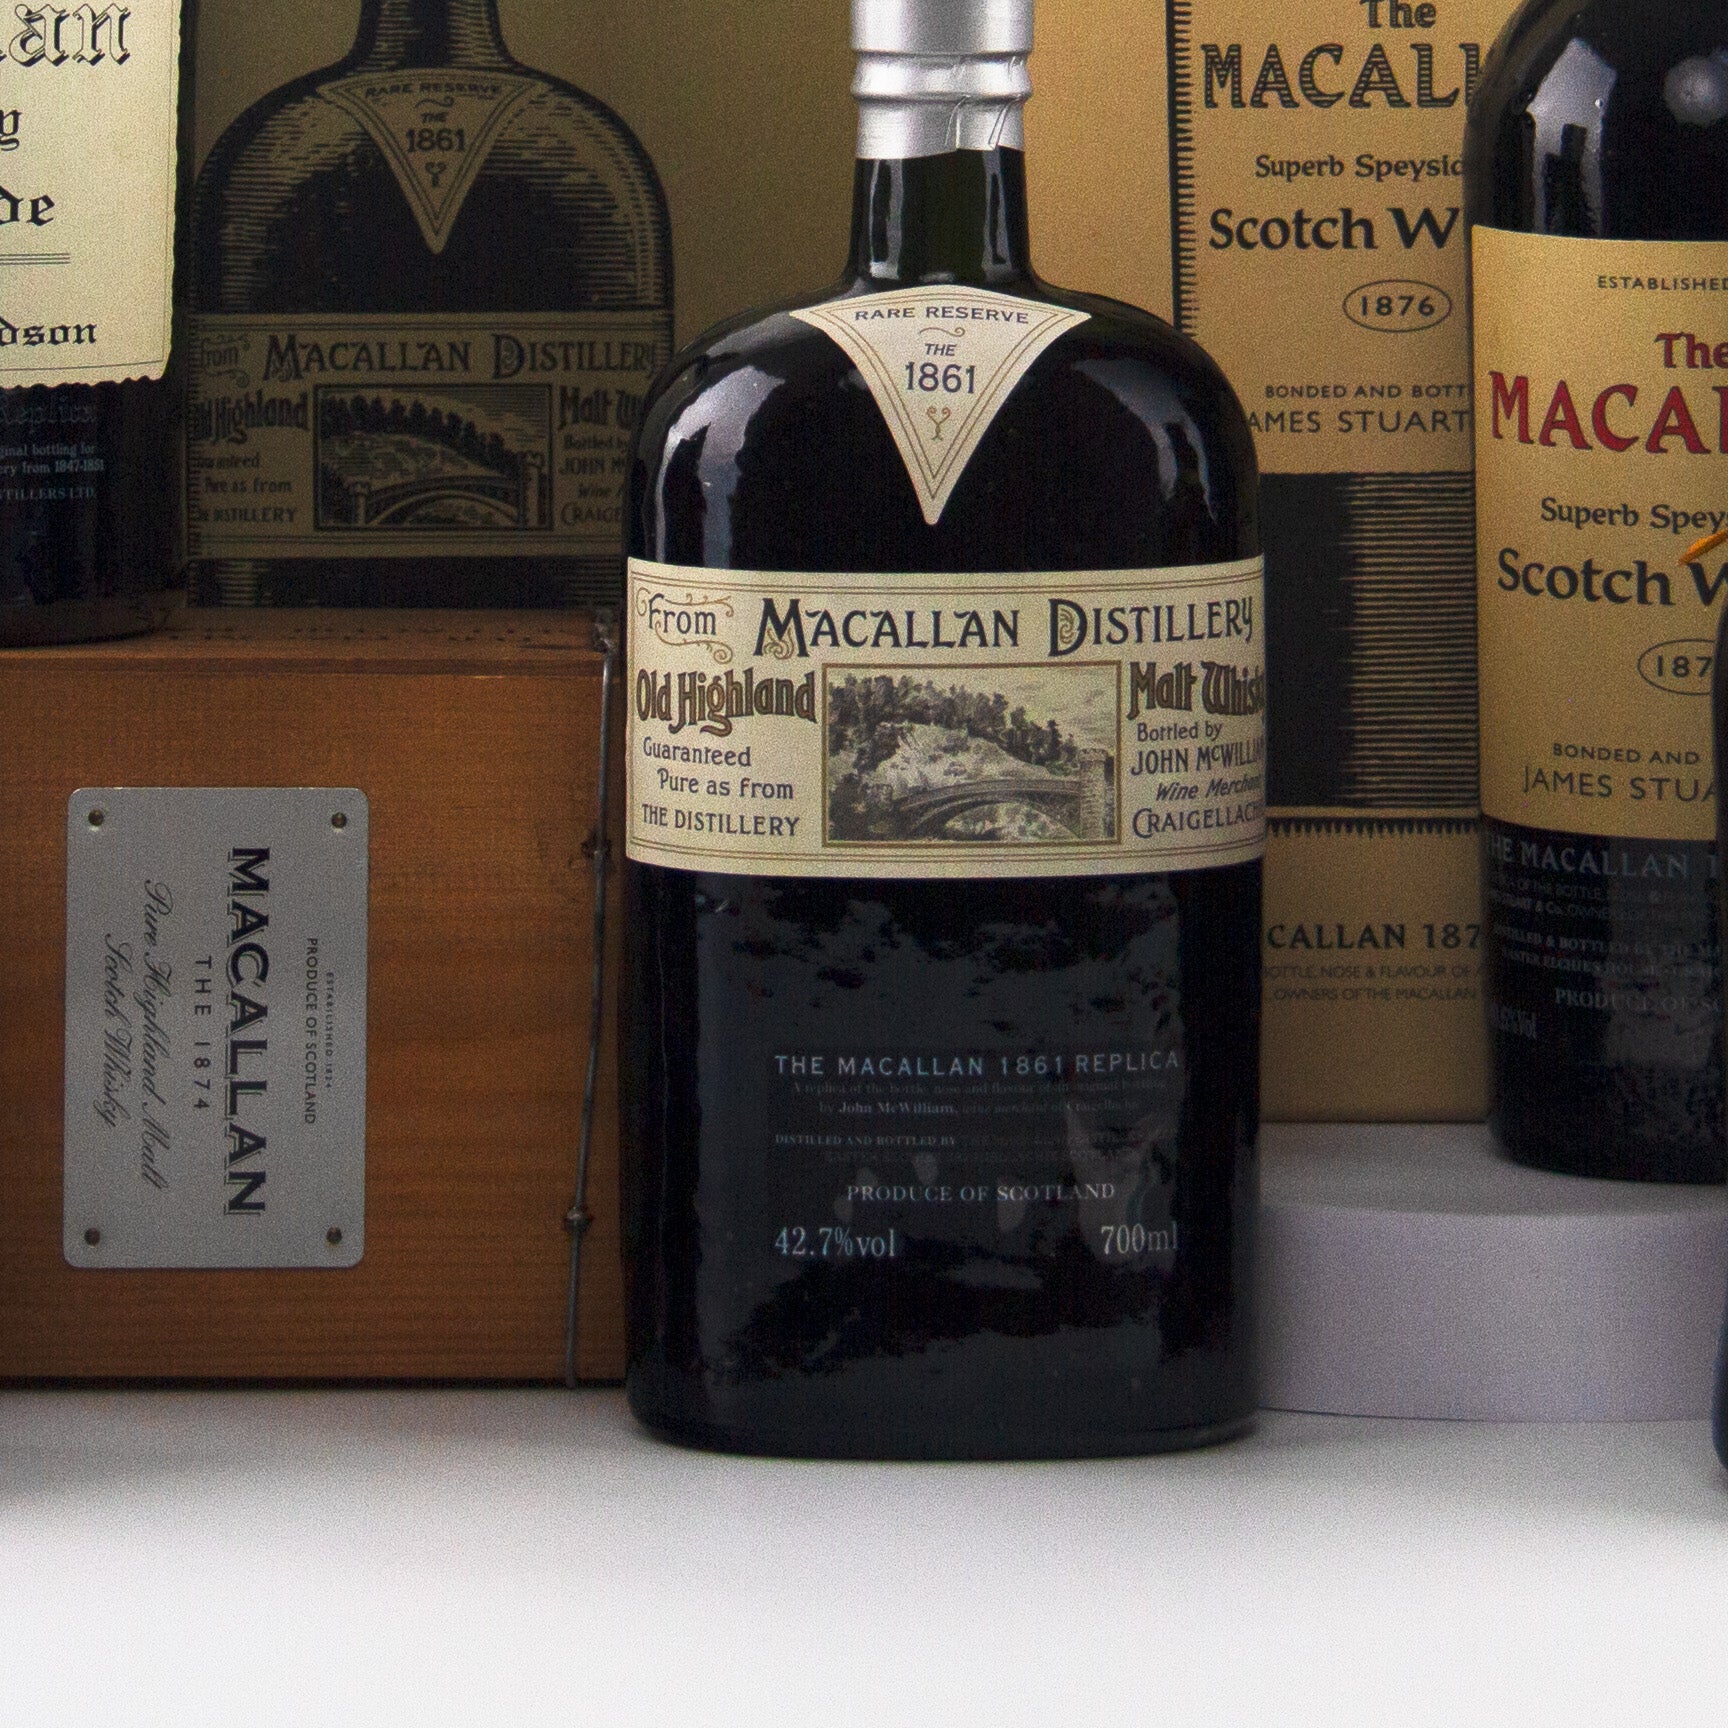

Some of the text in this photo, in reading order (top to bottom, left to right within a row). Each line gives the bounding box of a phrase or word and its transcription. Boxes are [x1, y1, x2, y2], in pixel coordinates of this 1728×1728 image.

[406, 127, 467, 154] 1861
[1254, 153, 1345, 183] Superb
[1208, 207, 1380, 251] Scotch
[854, 305, 1030, 326] RARE RESERVE
[1361, 294, 1436, 318] 1876
[263, 333, 473, 381] MACALLAN
[925, 342, 958, 358] THE
[904, 360, 977, 395] 1861
[1265, 384, 1403, 399] BONDED AND
[1337, 410, 1471, 434] STUART
[1540, 495, 1640, 529] Superb
[1497, 546, 1677, 607] Scotch
[646, 592, 1256, 660] From MACALLAN DISTILLERY
[635, 667, 818, 737] Old Highland
[1126, 660, 1198, 721] Malt
[1136, 720, 1224, 743] Bottled by
[642, 735, 753, 769] Guaranteed
[1130, 747, 1190, 776] JOHN
[1552, 742, 1701, 765] BONDED AND
[656, 766, 731, 797] Pure as
[1155, 782, 1199, 802] Wine
[1522, 765, 1613, 799] JAMES
[641, 803, 801, 837] THE DISTILLERY
[132, 879, 174, 1106] Pure Highland
[92, 932, 135, 1128] Scotch Whisky
[192, 954, 214, 1112] THE 1874
[223, 845, 272, 1216] MACALLAN
[303, 936, 320, 1125] PRODUCE OF SCOTLAND
[773, 1050, 1181, 1078] THE MACALLAN 1861 REPLICA
[846, 1182, 1116, 1203] PRODUCE OF SCOTLAND
[1099, 1220, 1180, 1256] 700ml
